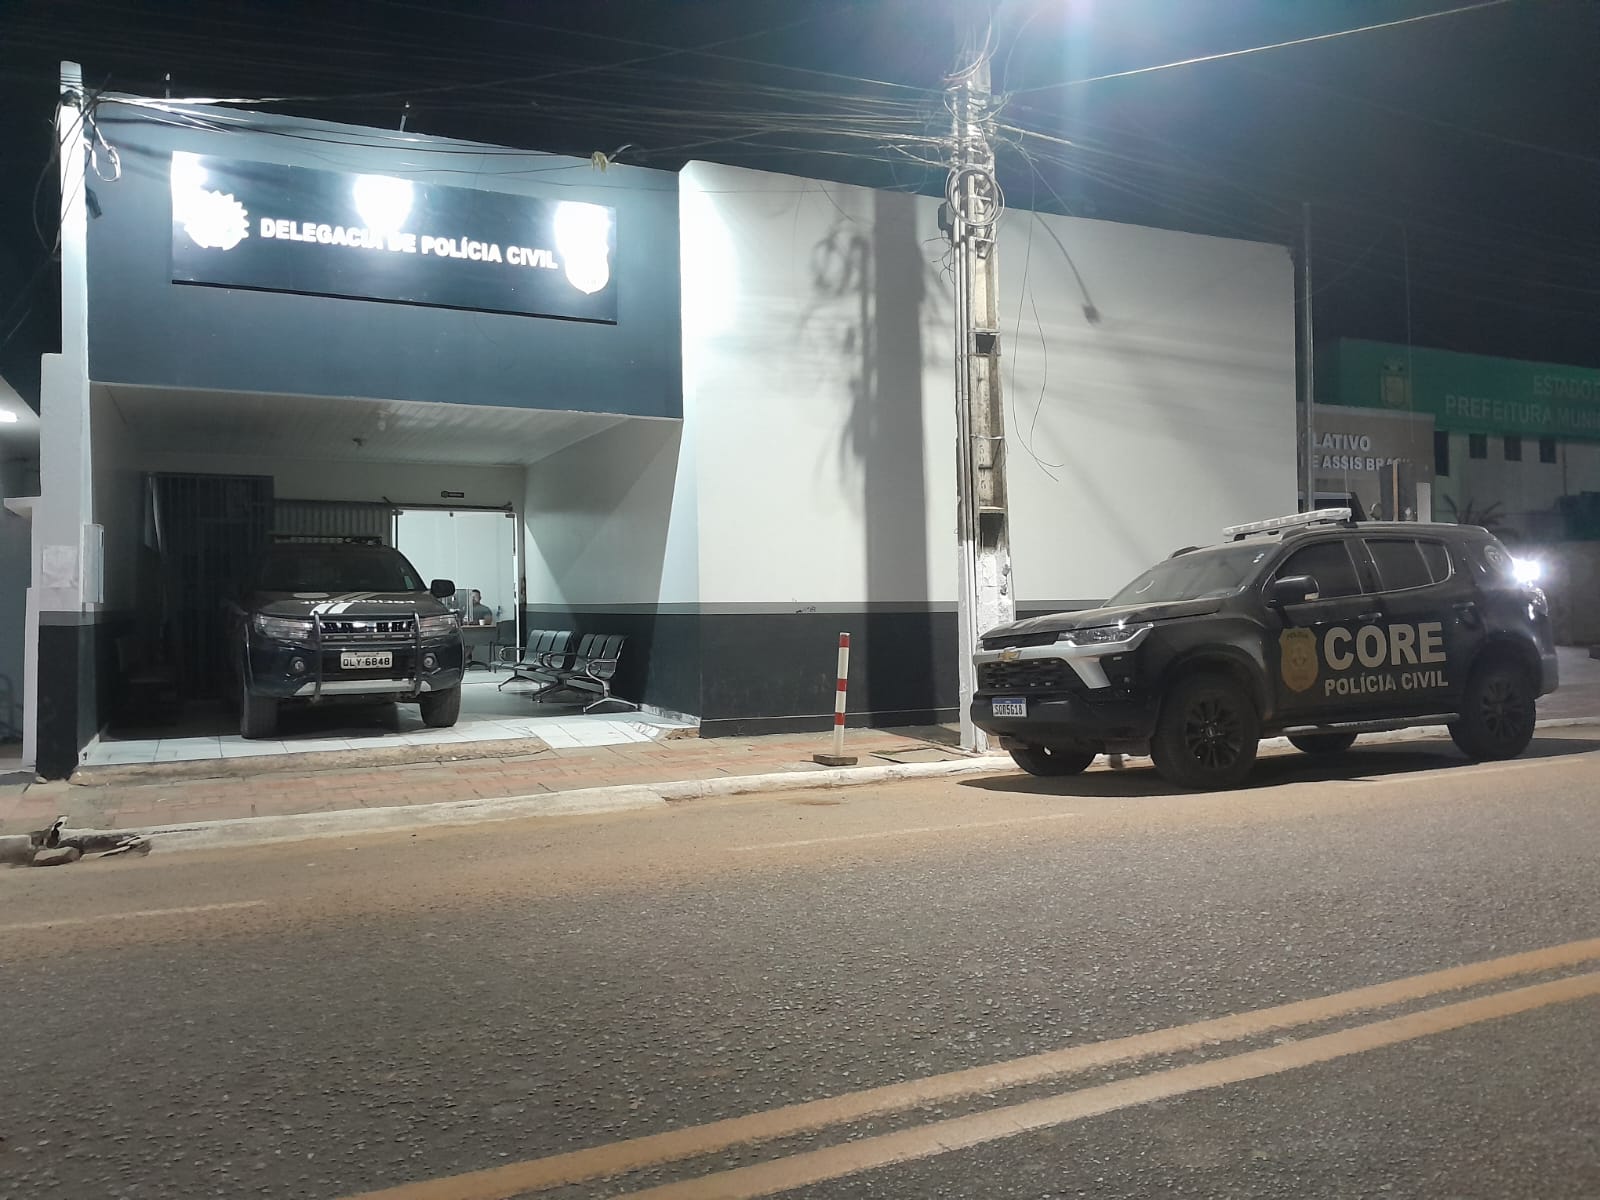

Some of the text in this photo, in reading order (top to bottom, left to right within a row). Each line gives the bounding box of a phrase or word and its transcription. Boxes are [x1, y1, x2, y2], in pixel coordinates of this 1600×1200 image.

[421, 236, 503, 263] POLÍCIA
[506, 246, 558, 269] CIVIL
[1445, 394, 1553, 425] PREFEITURA
[1322, 455, 1363, 471] ASSIS
[1324, 622, 1447, 671] CORE
[1325, 670, 1449, 696] POLÍCIA CIVIL
